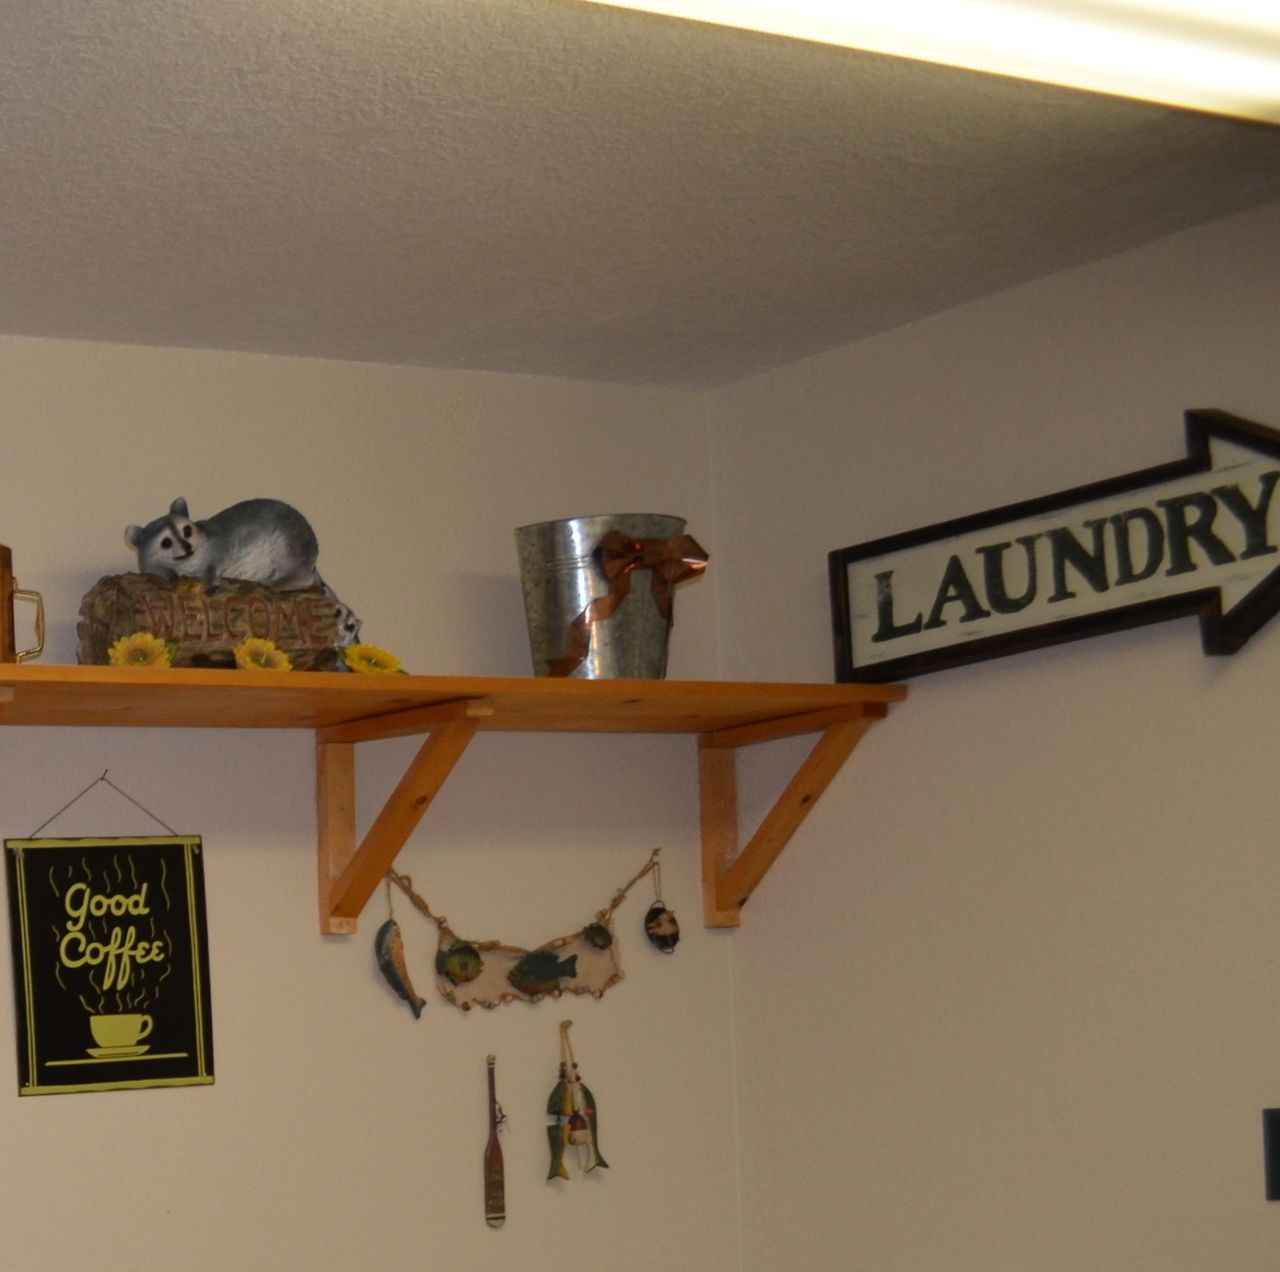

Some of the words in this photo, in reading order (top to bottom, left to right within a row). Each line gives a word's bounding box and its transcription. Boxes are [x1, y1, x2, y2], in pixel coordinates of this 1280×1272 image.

[871, 470, 1280, 643] LAUNDRY
[137, 594, 330, 646] WELCOME
[64, 881, 150, 931] Good
[59, 926, 166, 991] Coffee
